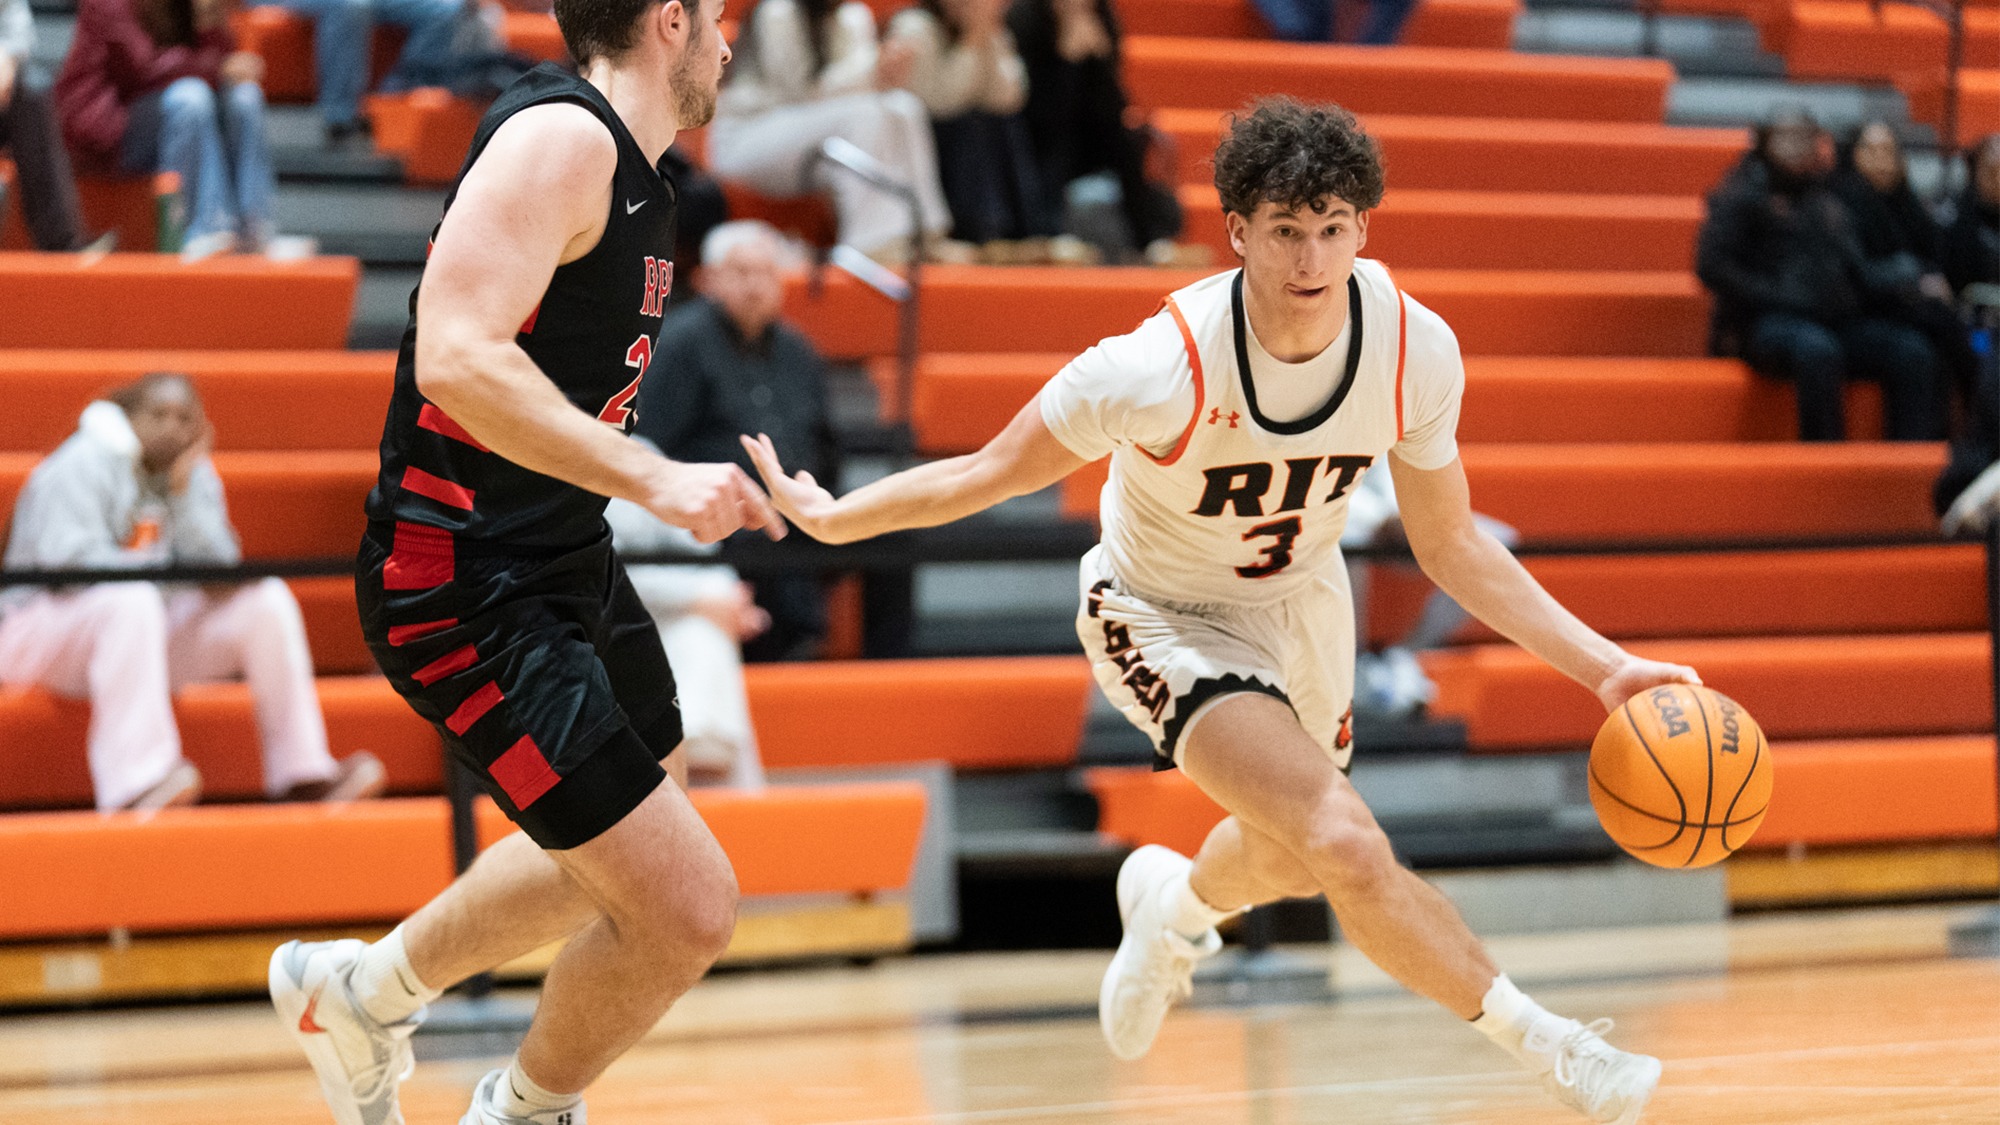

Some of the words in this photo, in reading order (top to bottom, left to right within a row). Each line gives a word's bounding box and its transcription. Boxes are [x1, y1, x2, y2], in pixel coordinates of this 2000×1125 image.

[597, 334, 659, 430] 2
[1188, 455, 1375, 517] RIT
[1234, 516, 1302, 578] 3
